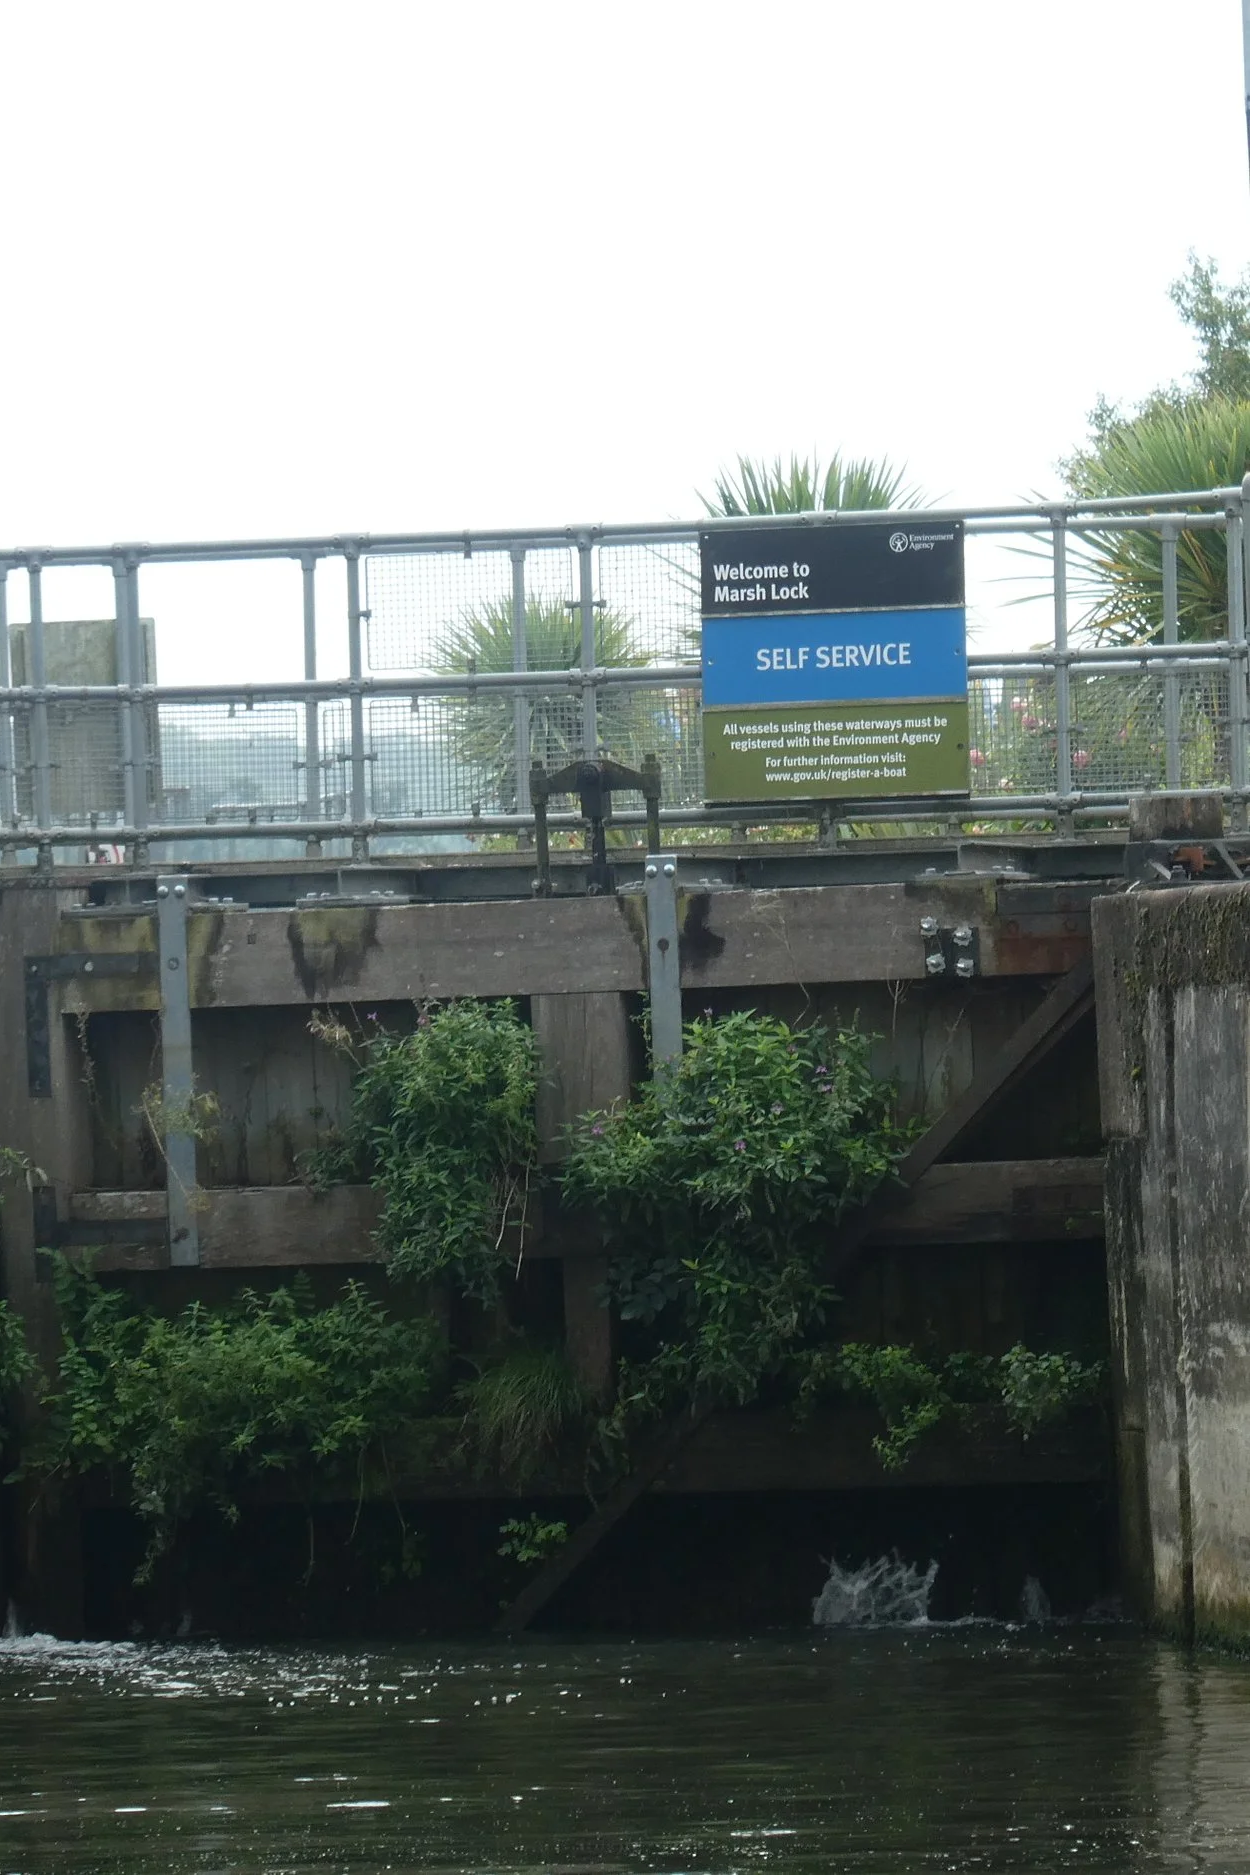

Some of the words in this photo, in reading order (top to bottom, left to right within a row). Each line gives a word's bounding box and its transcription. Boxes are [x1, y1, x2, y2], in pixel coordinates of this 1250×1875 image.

[909, 533, 954, 541] Environment
[909, 542, 934, 550] Agency
[713, 563, 789, 581] Welcome
[793, 562, 810, 578] to
[714, 584, 766, 602] Marsh
[771, 582, 809, 600] Lock
[756, 648, 810, 671] SELF
[815, 643, 912, 669] SERVICE
[723, 724, 738, 735] All
[739, 723, 779, 735] vessels
[781, 722, 811, 734] using
[813, 720, 844, 732] these
[845, 719, 902, 731] waterways
[904, 717, 932, 728] must
[934, 716, 948, 727] be
[731, 737, 784, 752] registered
[786, 735, 810, 748] with
[812, 735, 830, 747] the
[833, 733, 899, 746] Environment
[901, 732, 941, 745] Agency
[765, 757, 781, 768] For
[783, 755, 818, 767] further
[820, 753, 879, 765] information
[881, 752, 906, 764] visit:
[766, 768, 906, 782] www.gov.uk/register-a-boat
